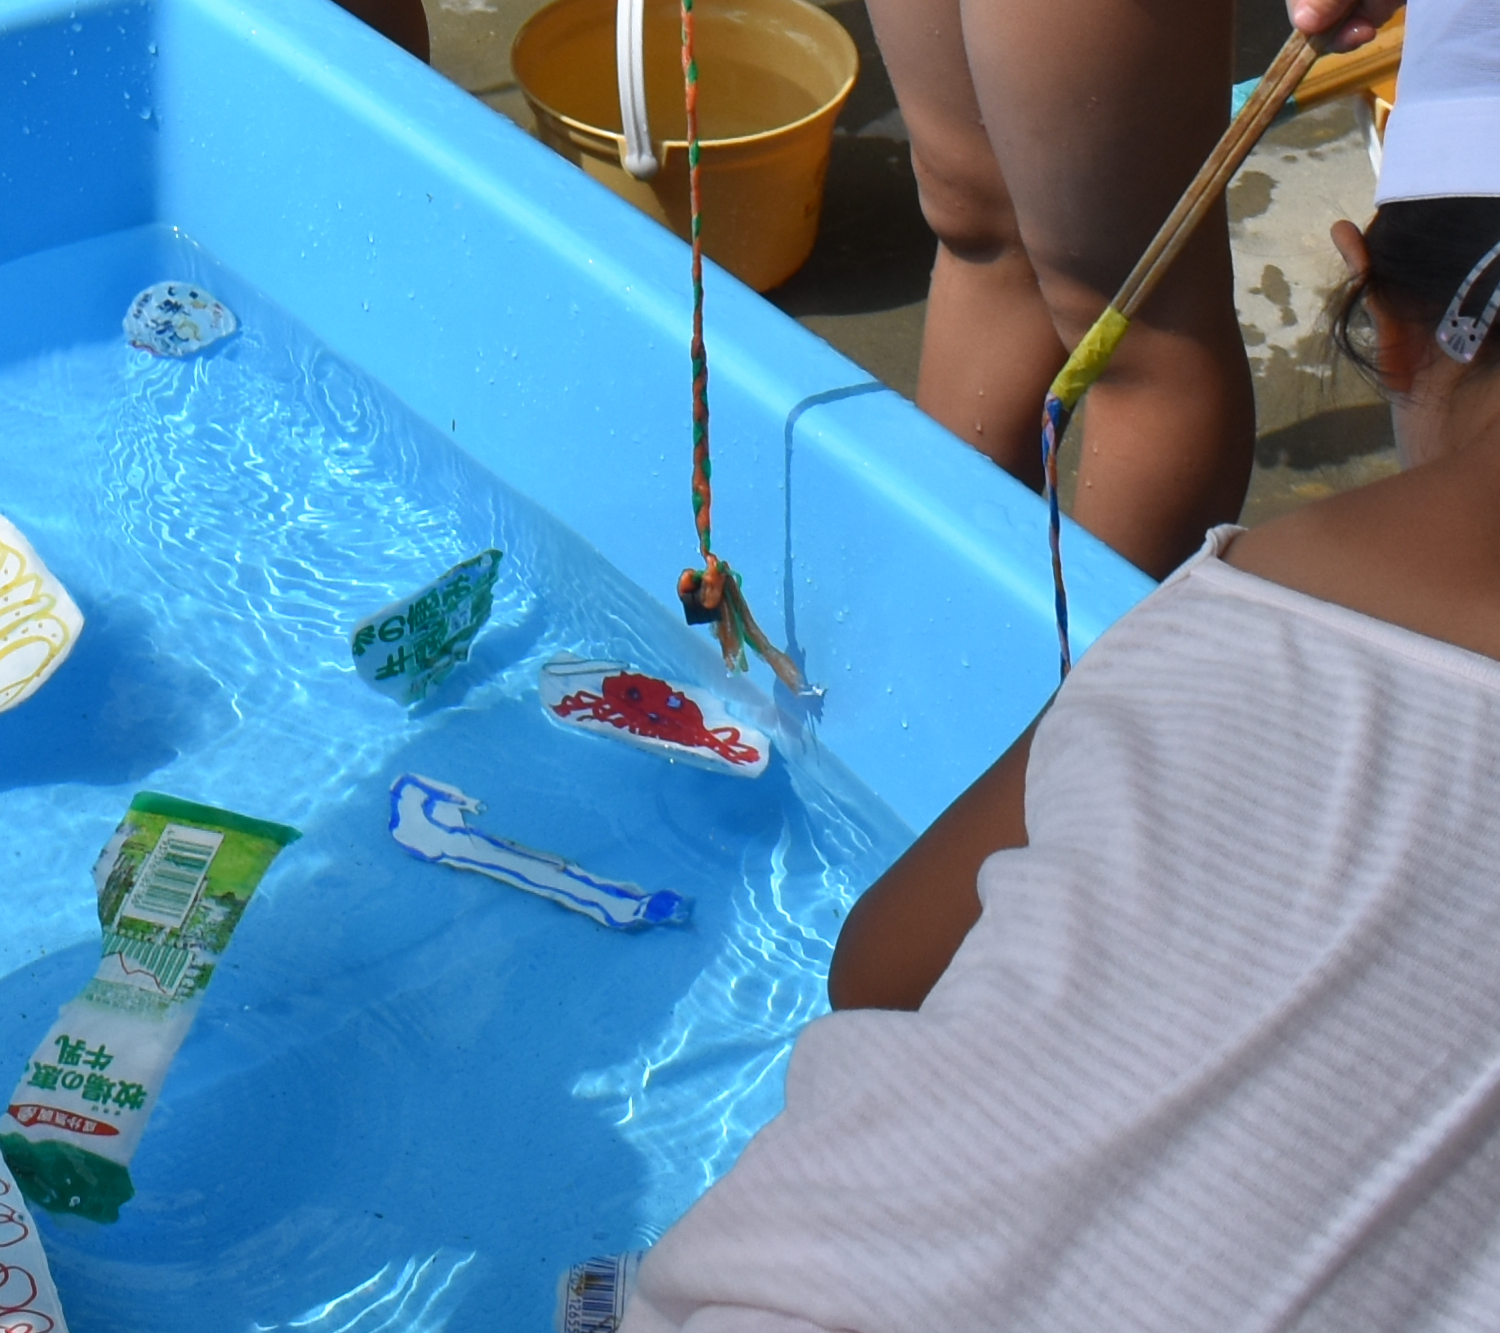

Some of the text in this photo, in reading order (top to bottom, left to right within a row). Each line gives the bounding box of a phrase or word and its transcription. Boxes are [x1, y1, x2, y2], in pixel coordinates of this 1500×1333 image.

[54, 1034, 114, 1072] 牛乳
[24, 1061, 148, 1111] 牧場の恵
